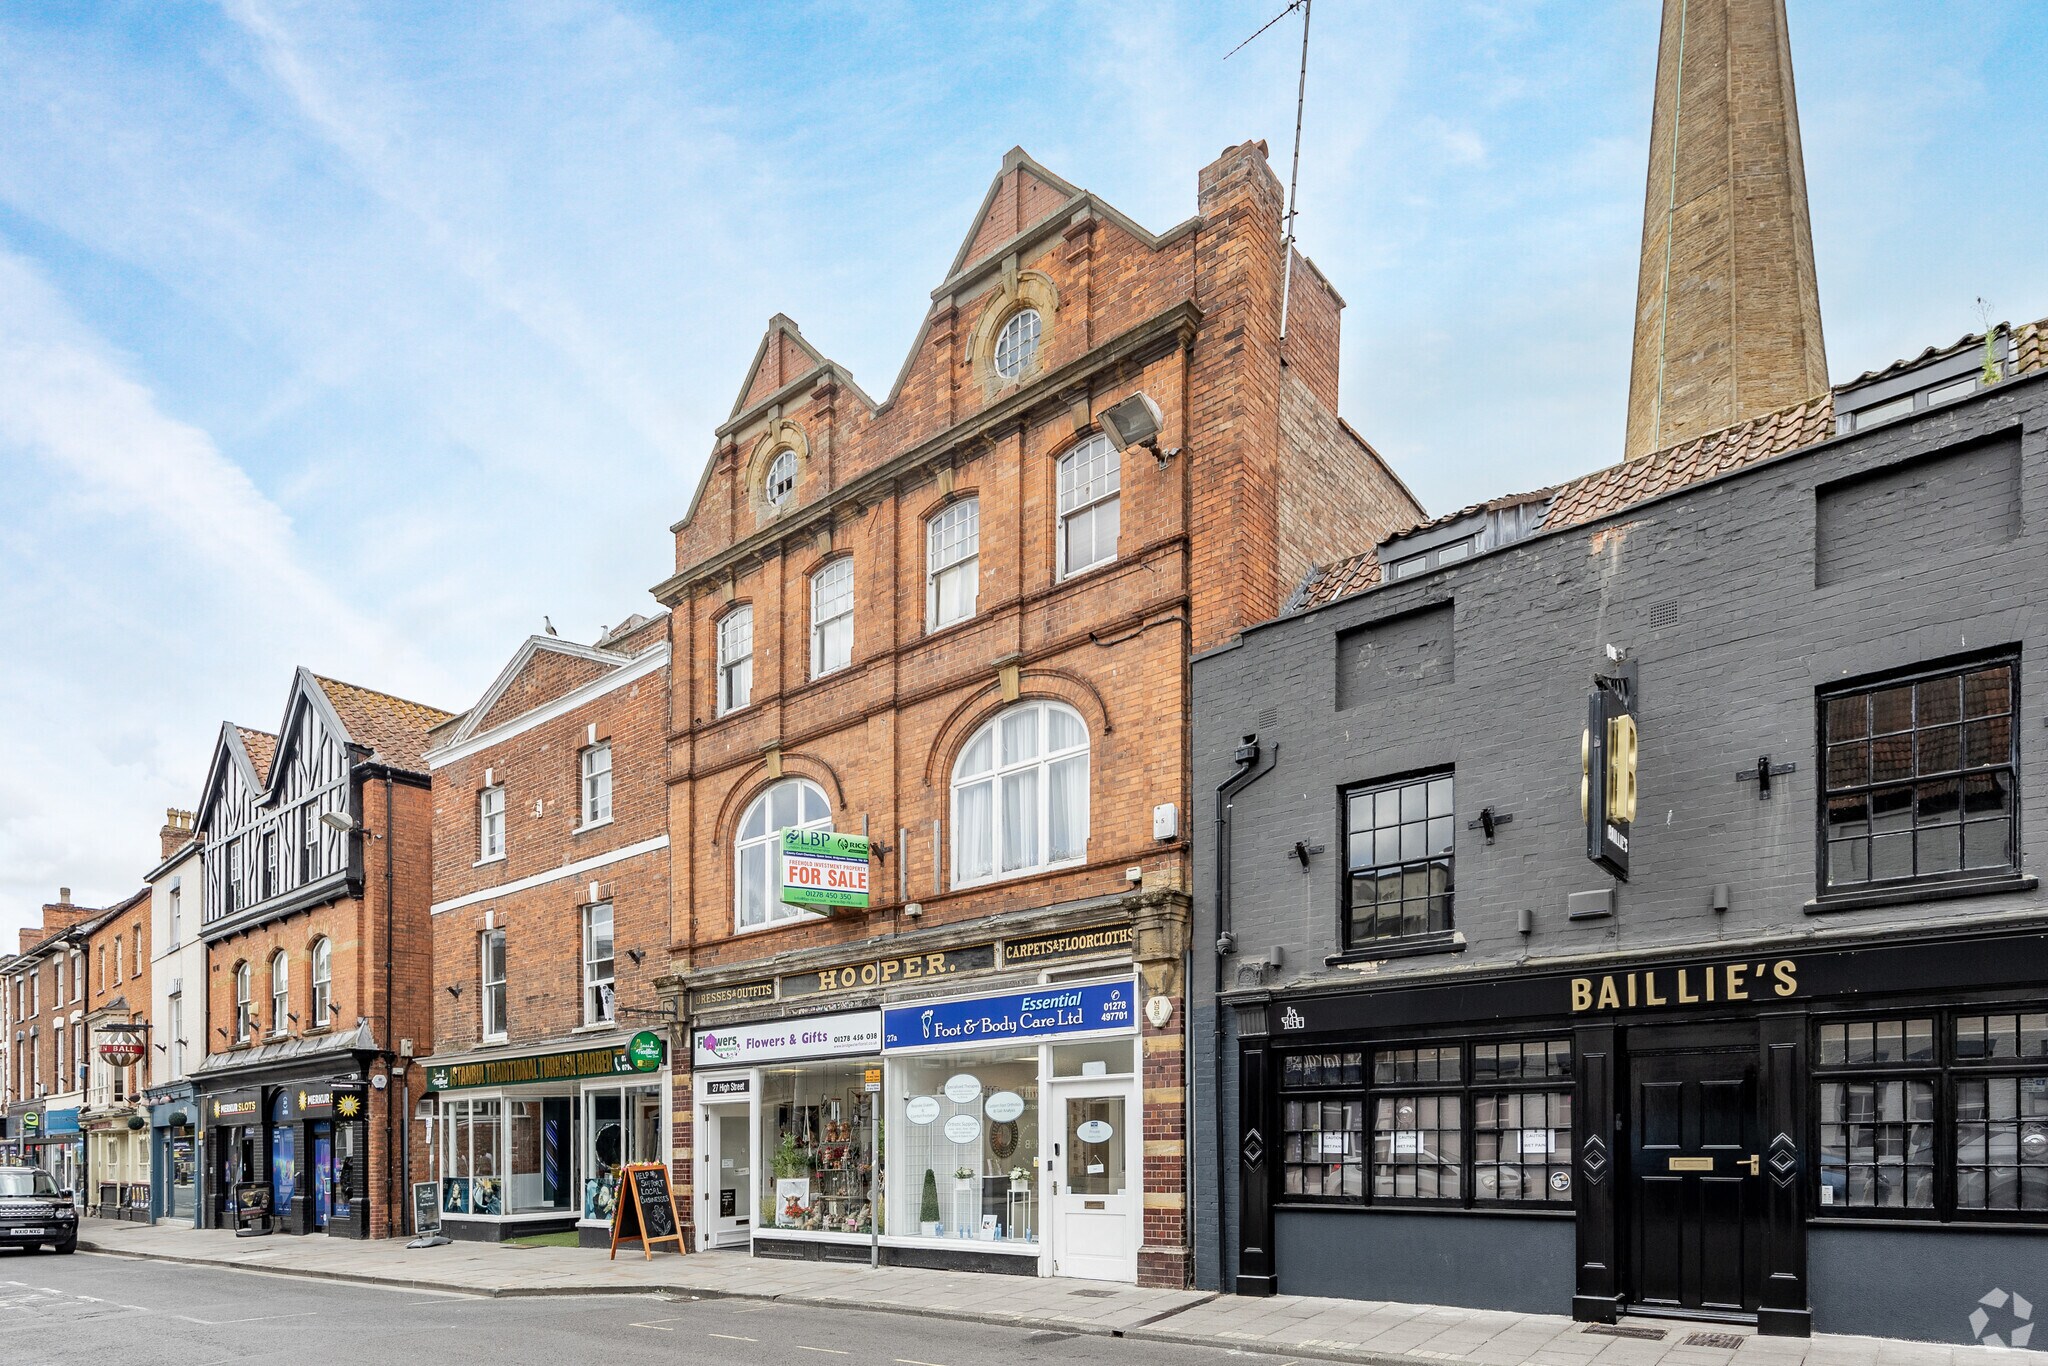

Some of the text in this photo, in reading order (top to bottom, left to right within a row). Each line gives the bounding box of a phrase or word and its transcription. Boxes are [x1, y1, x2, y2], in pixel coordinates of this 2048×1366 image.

[801, 831, 831, 847] LBP
[814, 861, 842, 869] INVESTMENT
[789, 866, 867, 889] FOR SALE
[806, 890, 824, 898] 01278
[1571, 960, 1798, 1011] BAILLIE'S
[1021, 991, 1083, 1012] Essential
[1103, 1001, 1127, 1011] 01278
[1101, 1010, 1128, 1022] 497701
[886, 1008, 1083, 1043] 27a Foot & Body Care Ltd
[697, 1034, 738, 1050] Flwers
[746, 1031, 828, 1050] Flowers & Gifts
[833, 1032, 878, 1043] 01278 456 038
[486, 1058, 539, 1083] TRADITIONAL
[539, 1054, 576, 1078] TURKISH
[577, 1049, 613, 1075] BARBER
[712, 1082, 745, 1093] 27 High Street
[307, 1093, 330, 1105] MERKUR
[238, 1101, 256, 1111] SLOTS
[635, 1172, 650, 1180] HELP
